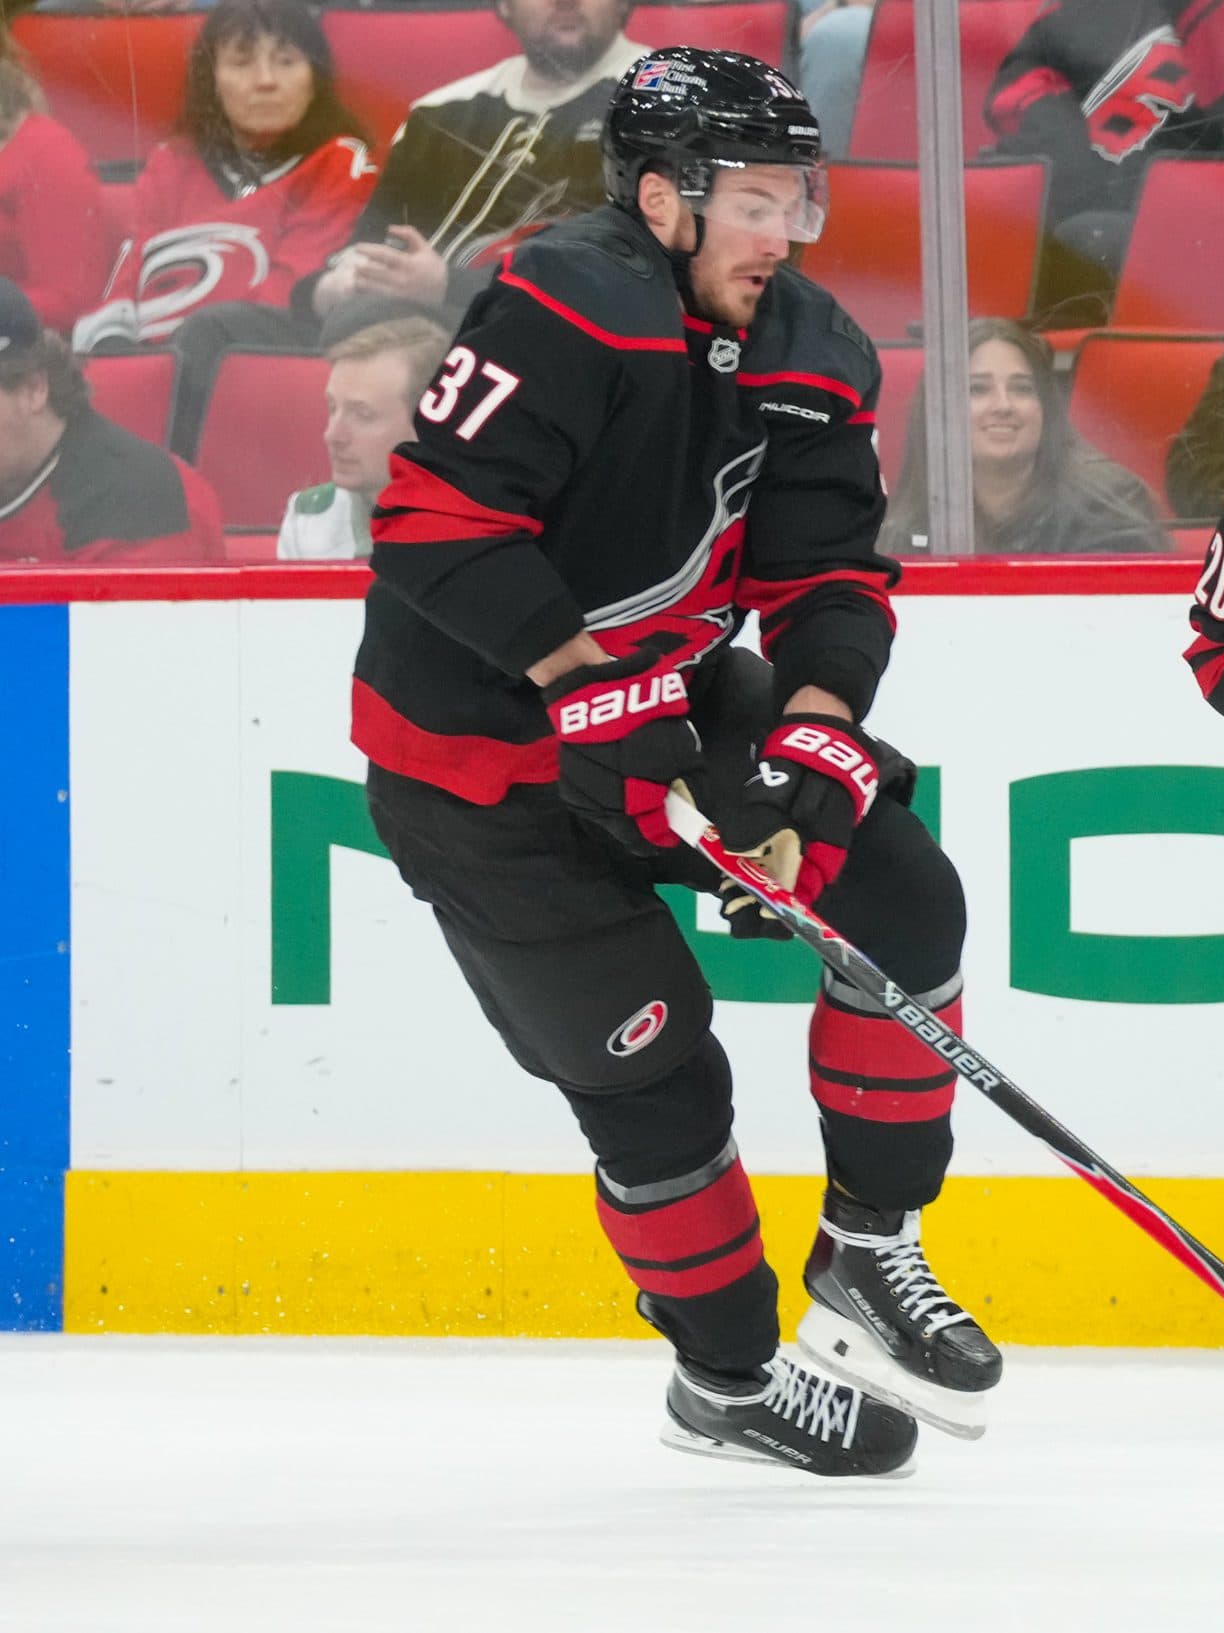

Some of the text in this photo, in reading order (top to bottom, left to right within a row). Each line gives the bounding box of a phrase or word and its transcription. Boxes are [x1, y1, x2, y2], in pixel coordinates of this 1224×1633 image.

[418, 345, 522, 442] 37
[758, 402, 830, 424] NUCOR
[559, 671, 689, 735] BAUE
